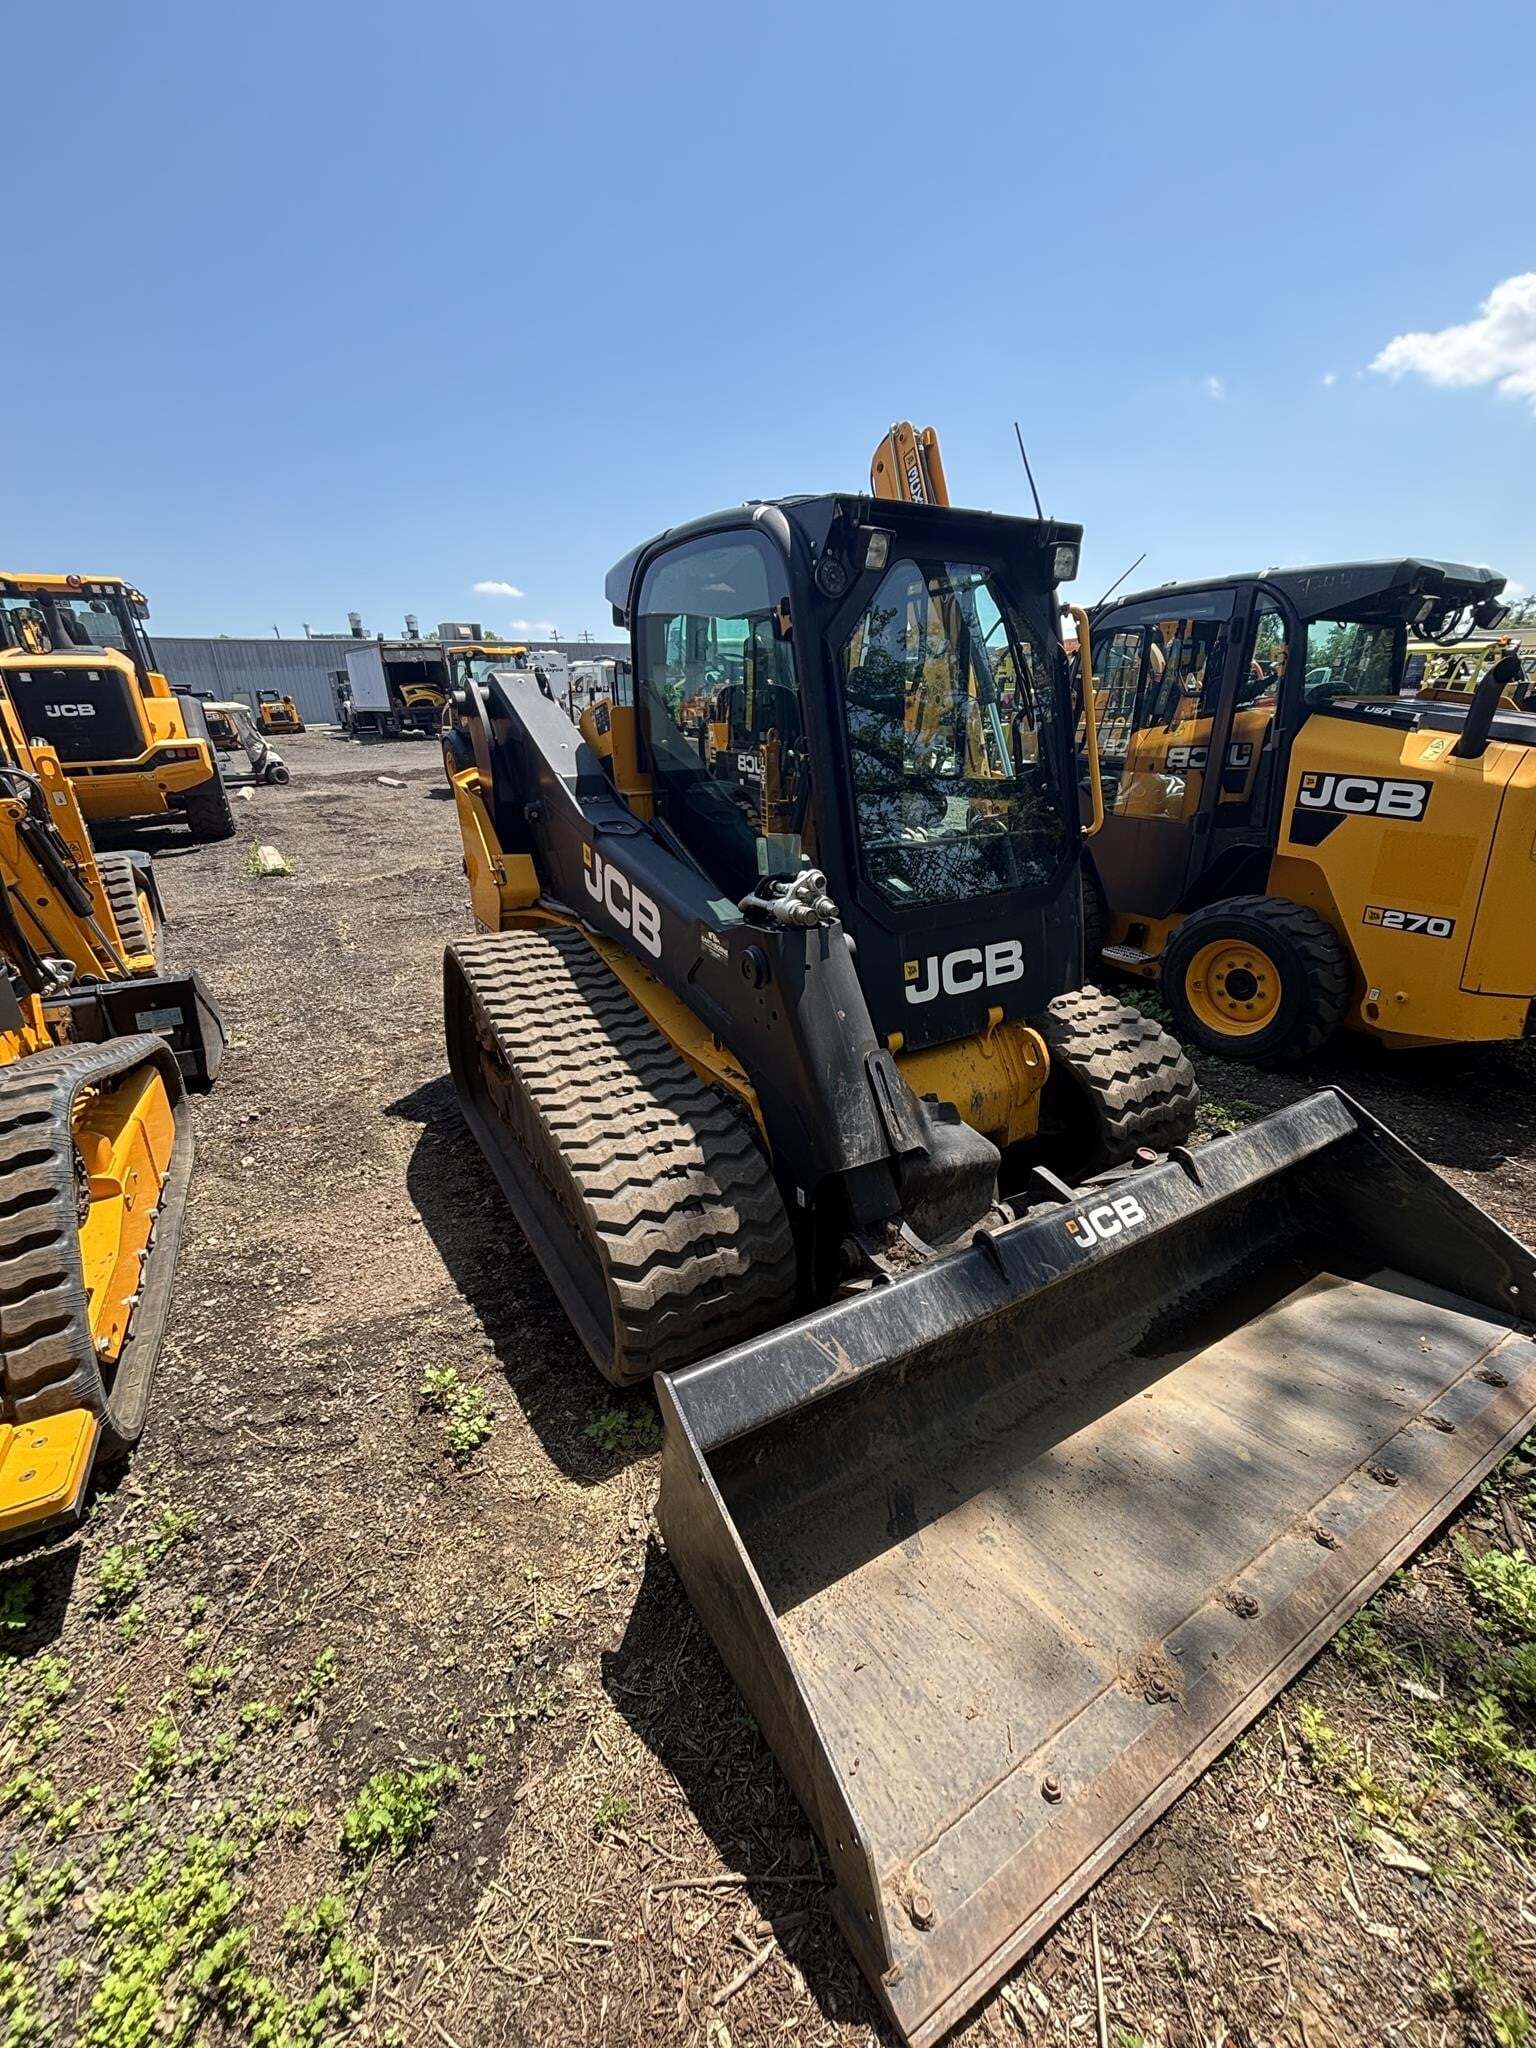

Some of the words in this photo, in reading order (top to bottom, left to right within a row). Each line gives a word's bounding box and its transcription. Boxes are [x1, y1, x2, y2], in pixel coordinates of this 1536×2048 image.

[45, 703, 96, 717] JCB
[1363, 706, 1393, 717] USA
[1300, 776, 1426, 817] JCB
[583, 852, 662, 958] JCB
[1382, 910, 1451, 937] 270
[905, 940, 1024, 1004] JCB
[1073, 1195, 1147, 1248] JCB
